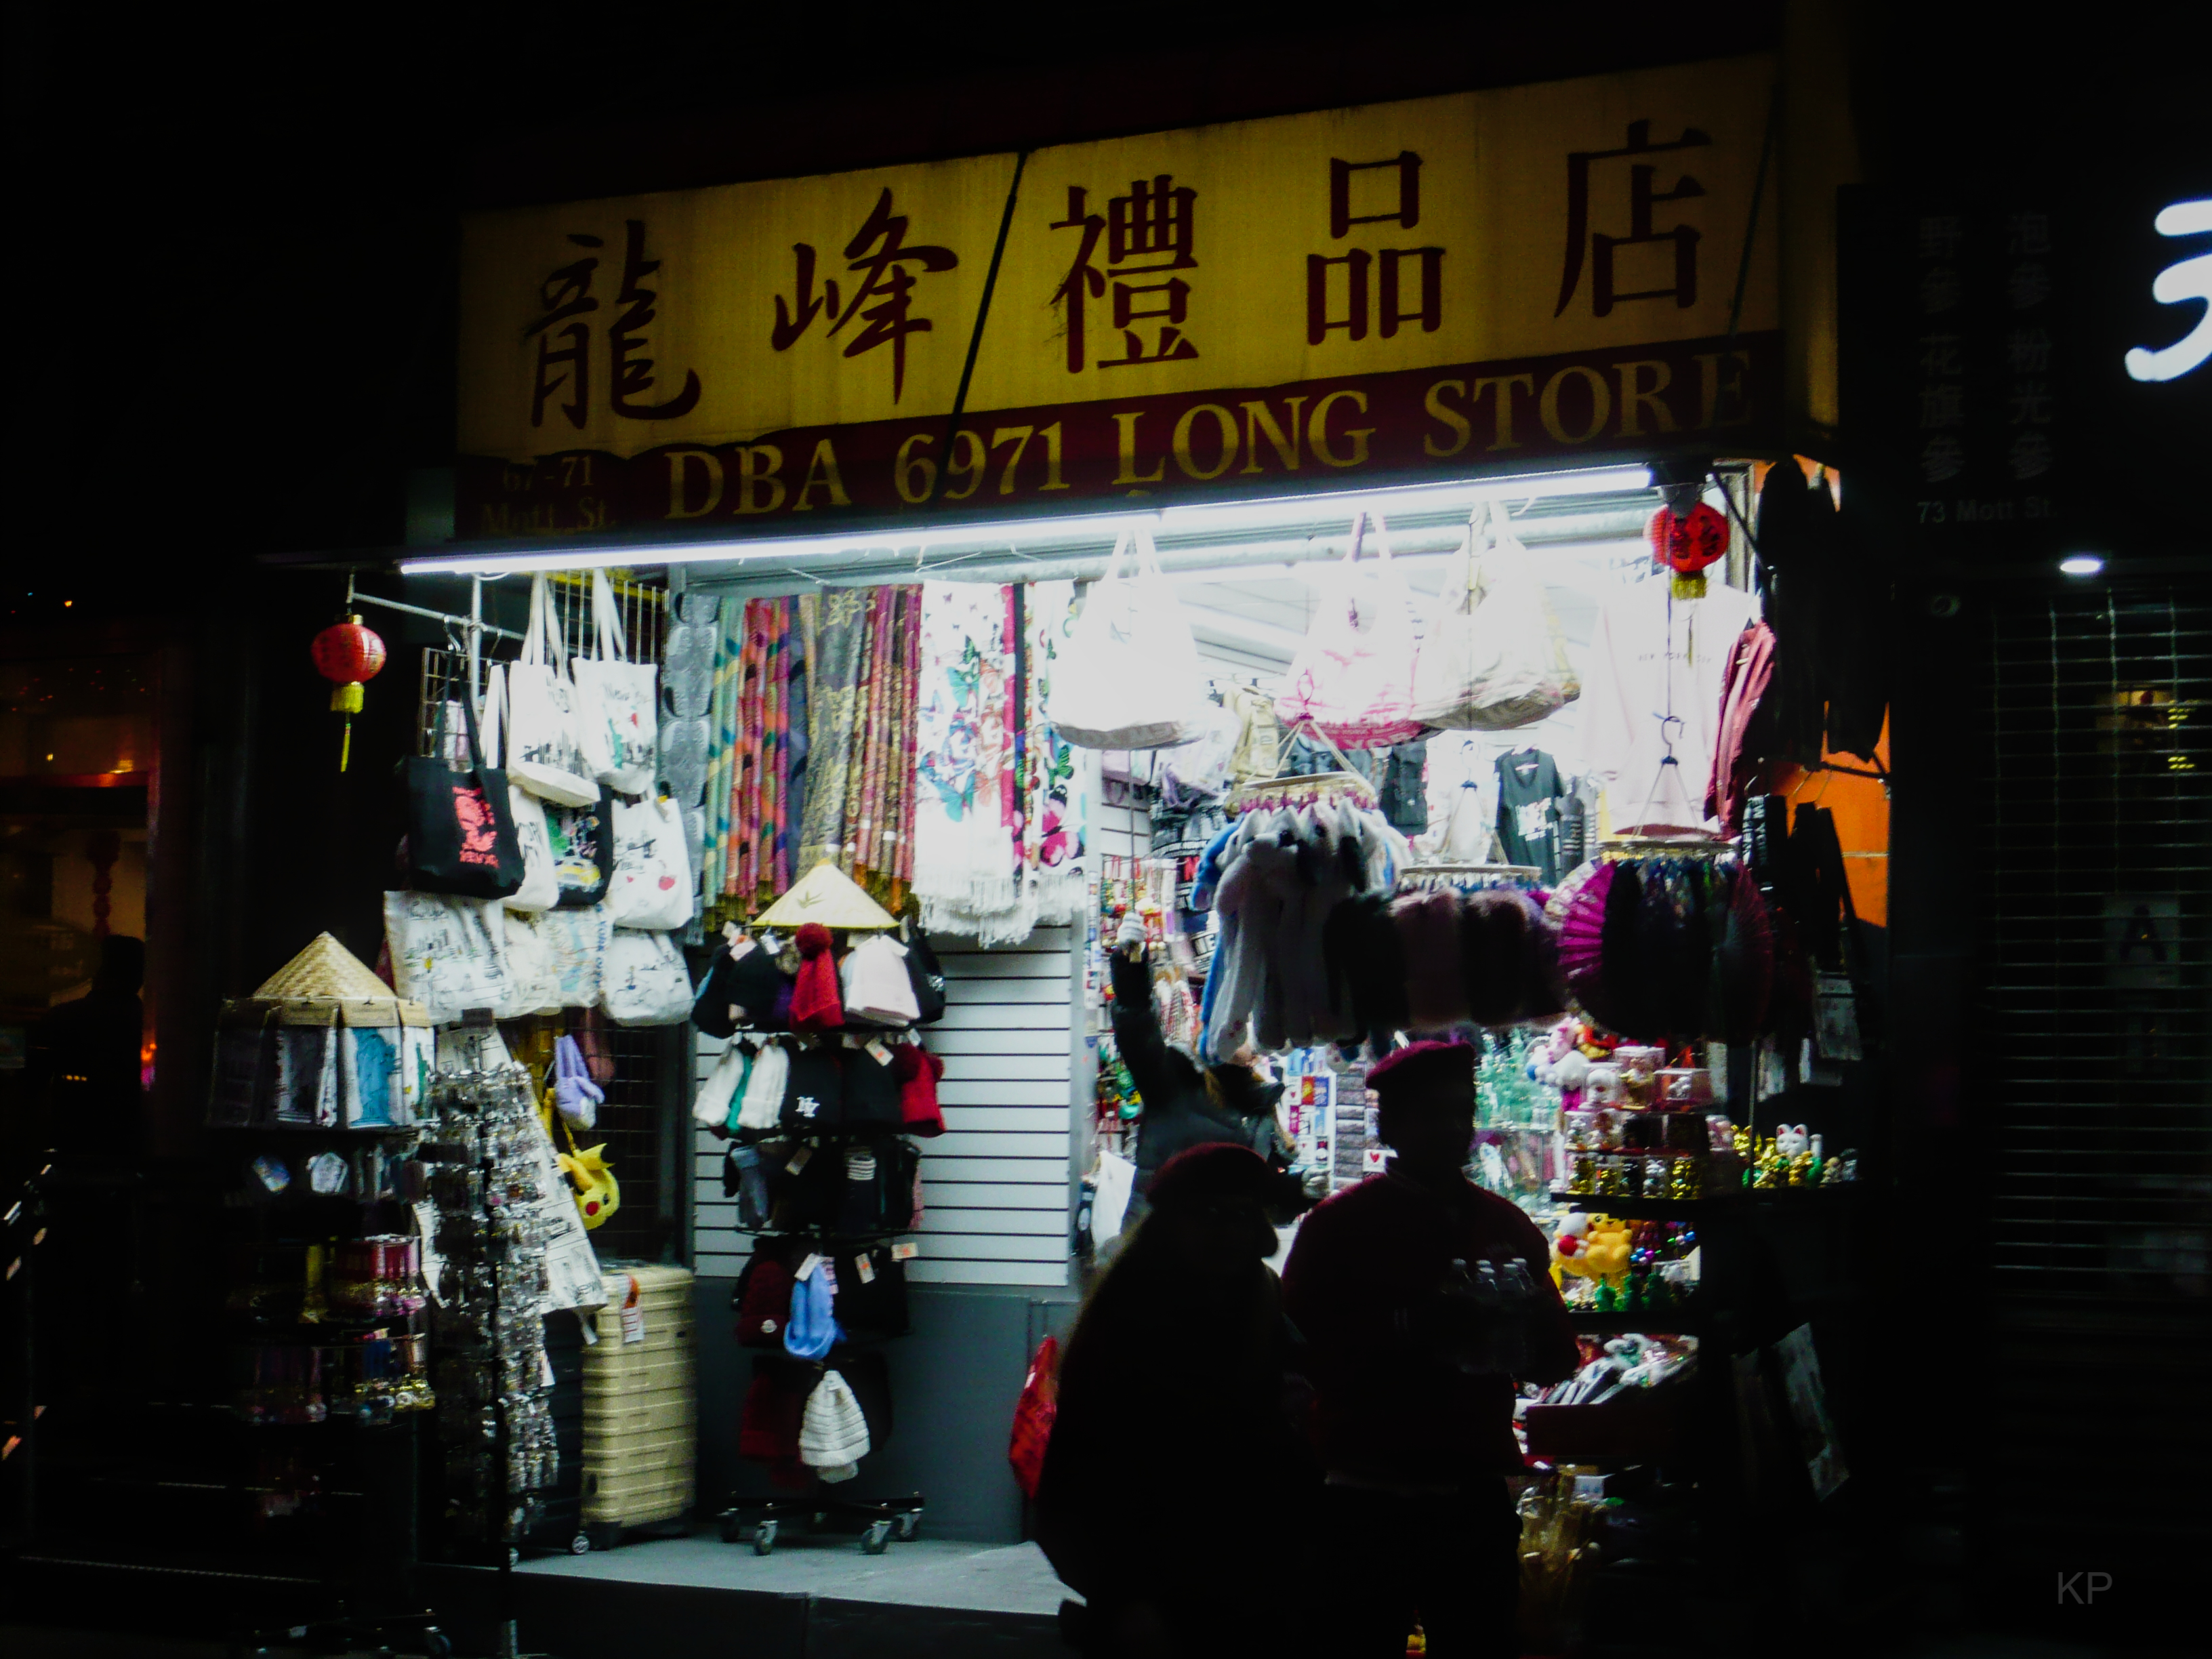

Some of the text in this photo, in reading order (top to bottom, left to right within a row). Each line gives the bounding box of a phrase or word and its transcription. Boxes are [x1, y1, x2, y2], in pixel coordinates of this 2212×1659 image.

[522, 118, 1715, 432] 龍峰禮品店
[663, 349, 1752, 520] DBA 6971 LONG STORE
[1917, 500, 1946, 525] 73
[1956, 498, 2015, 522] Mott
[2119, 905, 2167, 963] A
